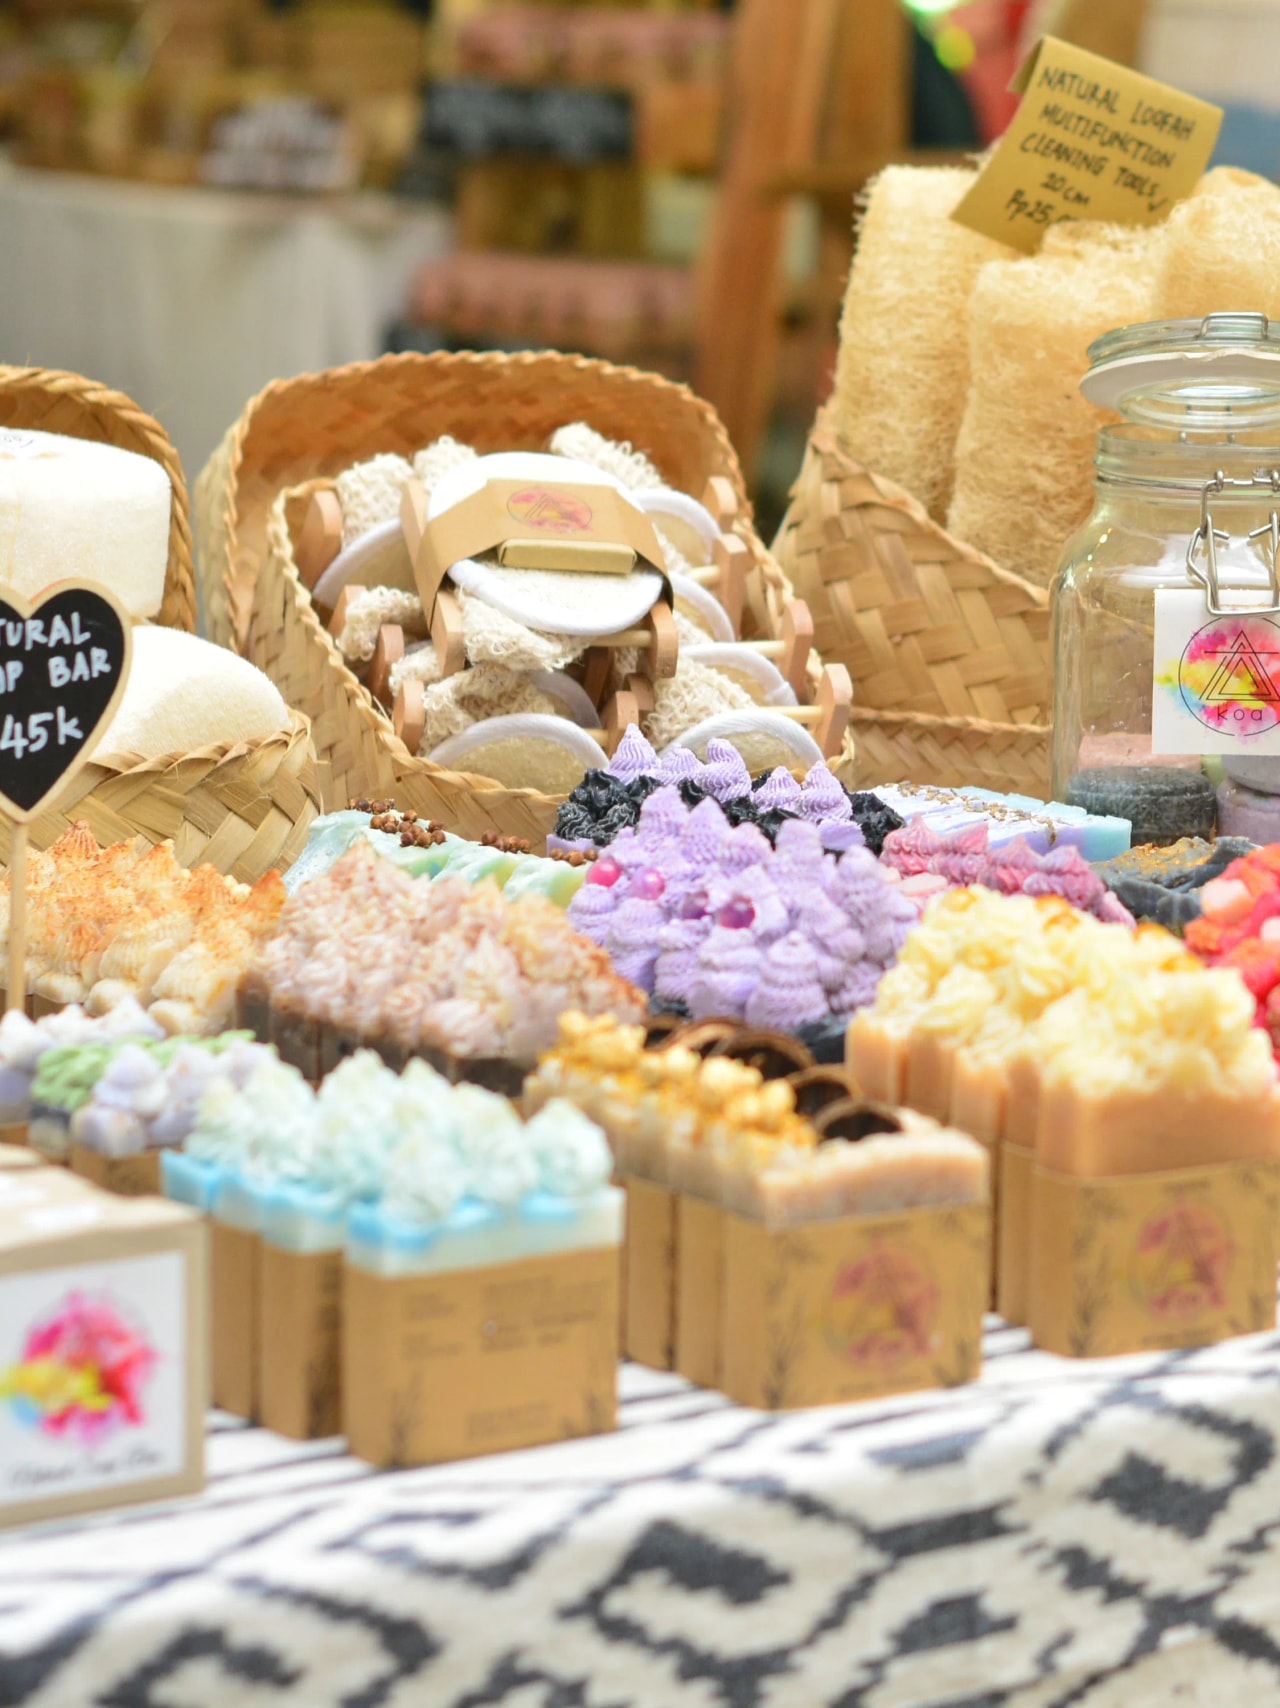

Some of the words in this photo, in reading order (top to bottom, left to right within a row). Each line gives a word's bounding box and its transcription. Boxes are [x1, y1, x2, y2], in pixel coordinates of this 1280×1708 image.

[1037, 66, 1121, 114] NATURAL
[1130, 101, 1196, 141] LOOFAH
[1040, 102, 1177, 169] MULTIFUNCTION
[1020, 132, 1110, 176] CLEANING
[1114, 166, 1161, 199] TOOLS
[48, 646, 112, 688] BAR
